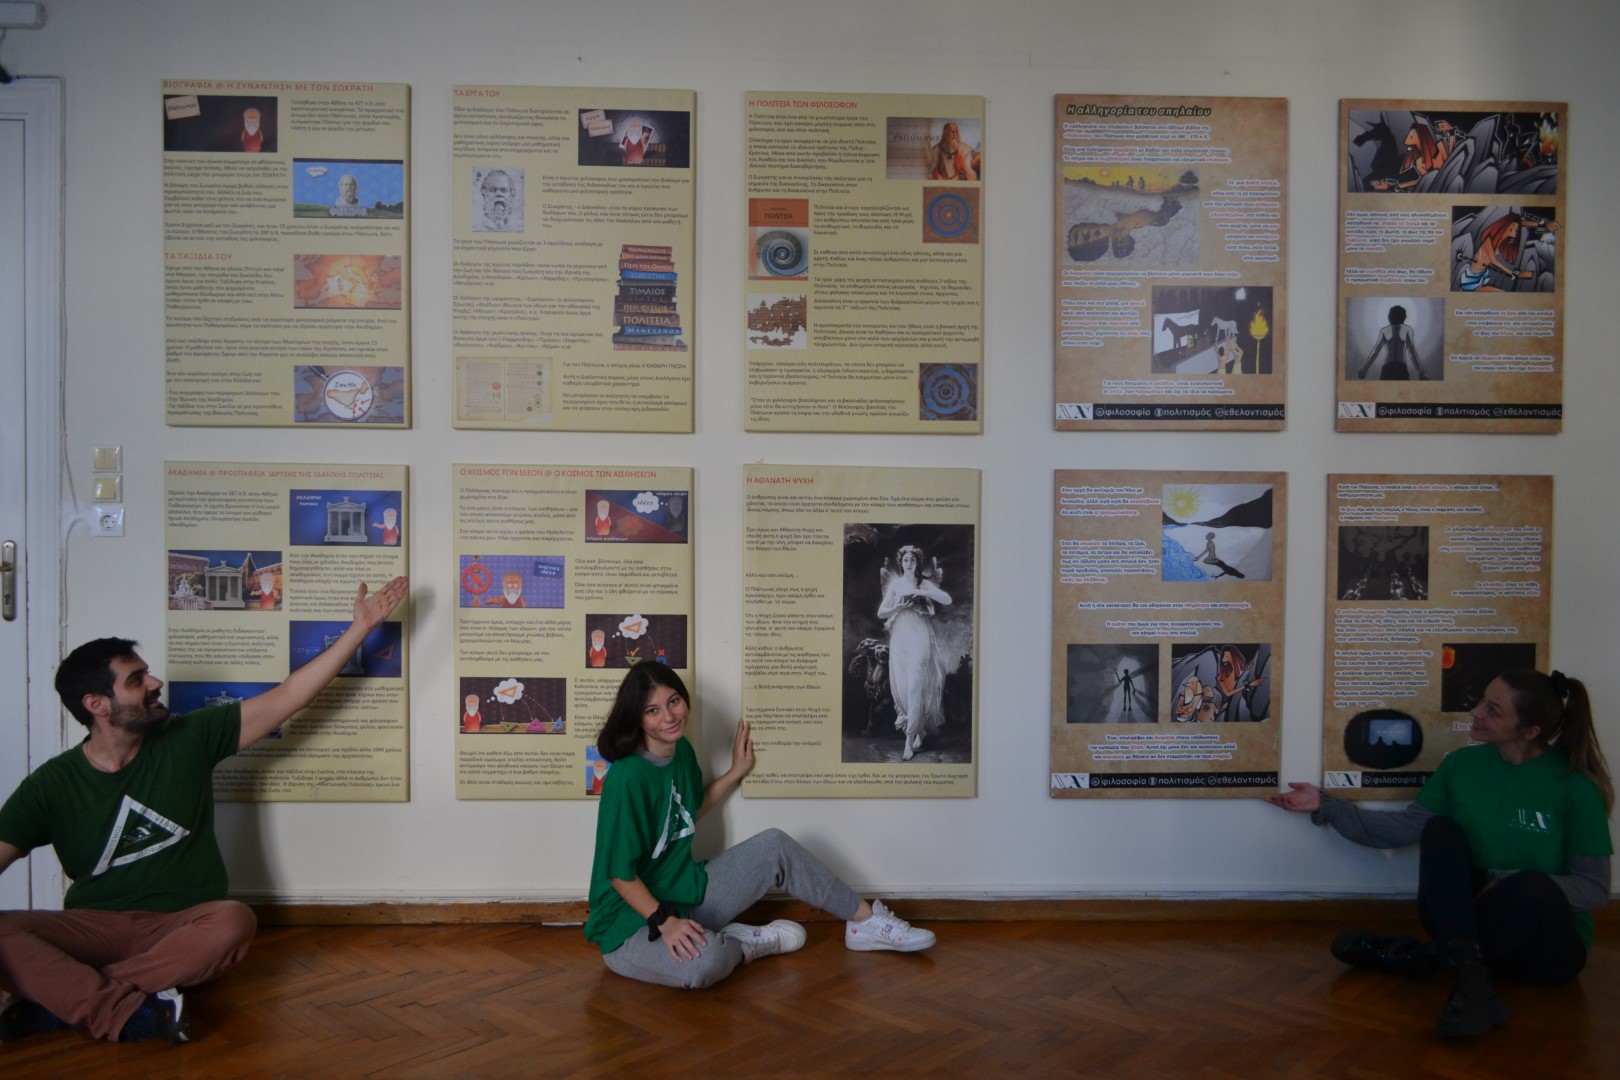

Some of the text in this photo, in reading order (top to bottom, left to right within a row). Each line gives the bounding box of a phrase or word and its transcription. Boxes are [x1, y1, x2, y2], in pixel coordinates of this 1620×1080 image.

[1067, 106, 1076, 114] Η
[1077, 106, 1134, 116] αλληγορία
[1158, 106, 1211, 117] σπηλαίου
[624, 316, 671, 324] ΠΟΛΙΤΕΙΑ
[1105, 408, 1150, 417] φιλοσοφία
[1163, 408, 1211, 417] πολιτισμός
[1224, 408, 1284, 417] εθελοντισμός
[1387, 408, 1432, 416] φιλοσοφία
[1444, 407, 1490, 417] πολιτισμός
[1503, 407, 1561, 417] εθελοντισμός
[1101, 777, 1147, 786] φιλοσοφία
[1158, 776, 1205, 786] πολιτισμός
[1217, 775, 1277, 785] εθελοντισμός
[1372, 776, 1417, 785] φιλοσοφία
